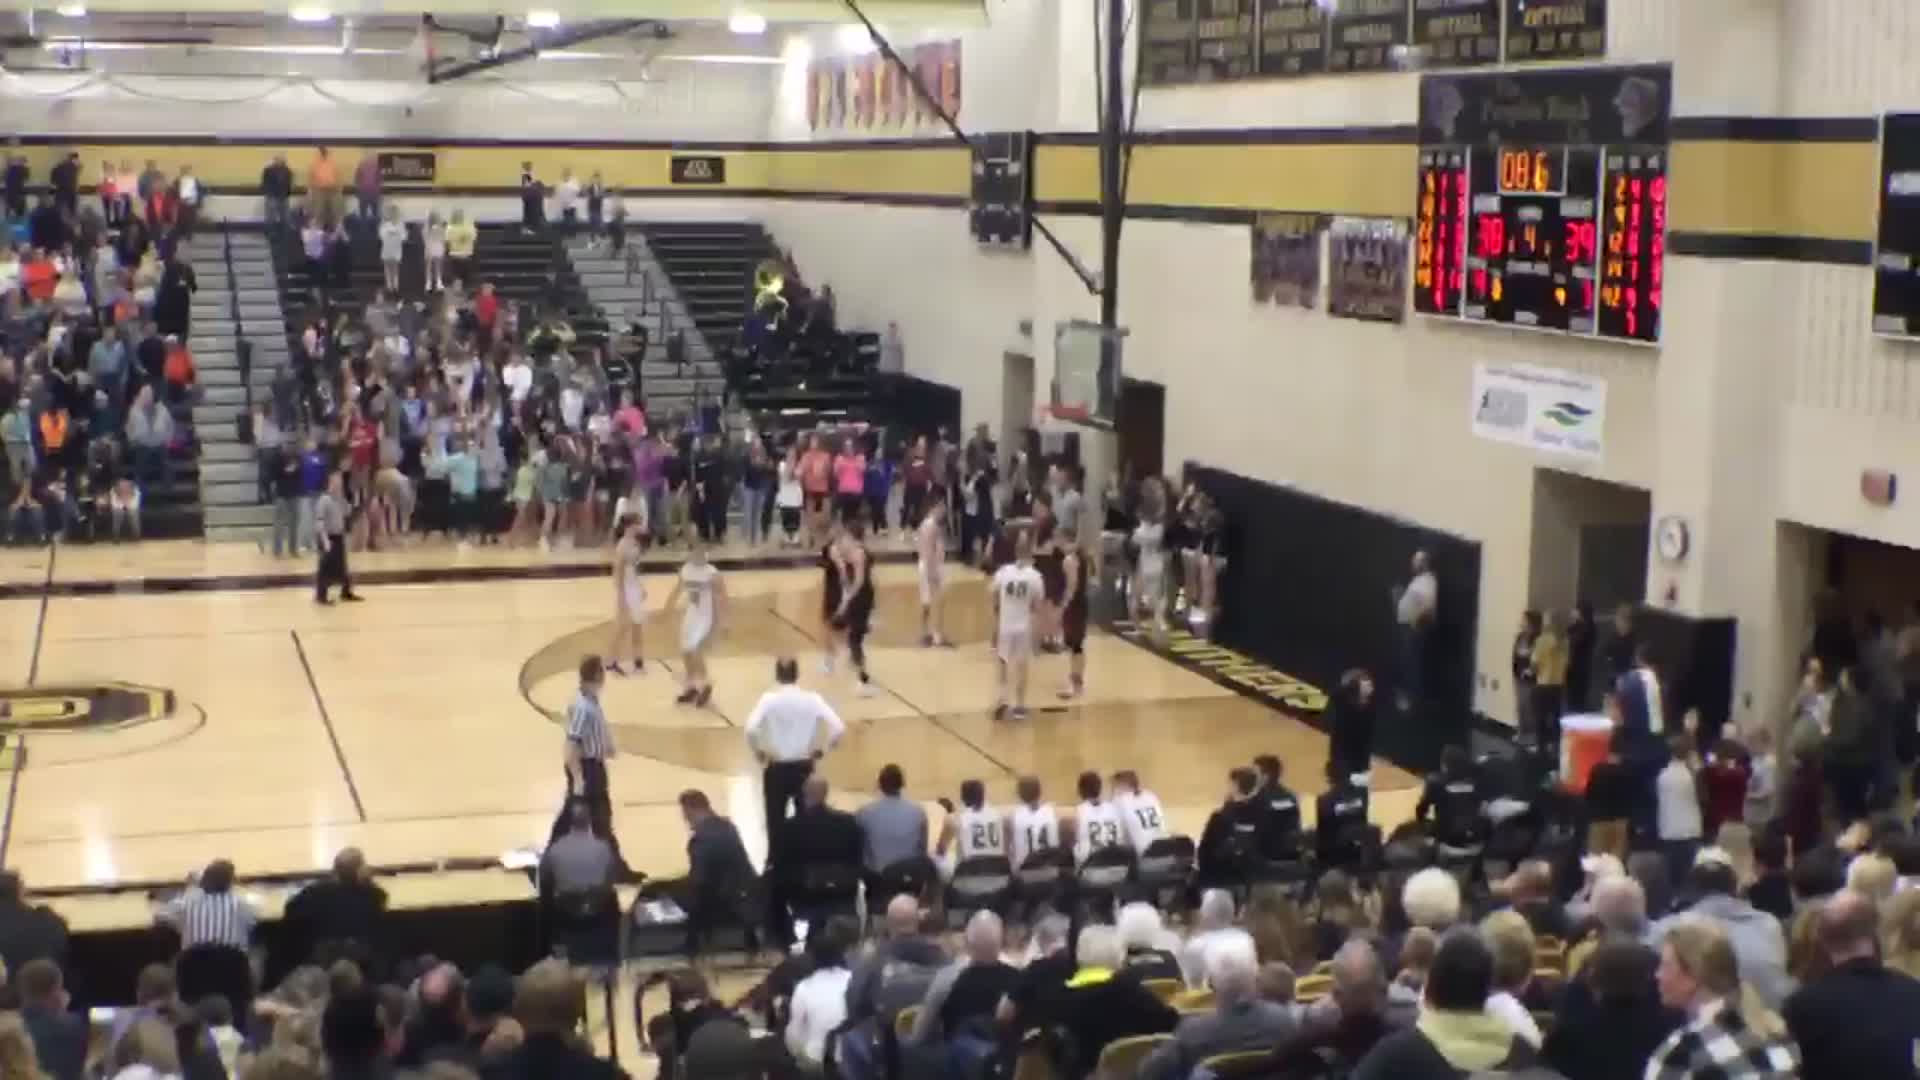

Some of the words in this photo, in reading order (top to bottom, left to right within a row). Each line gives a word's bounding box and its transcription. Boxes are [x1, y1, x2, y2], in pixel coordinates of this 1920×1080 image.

[1564, 221, 1596, 264] 39
[1136, 805, 1159, 829] 12
[972, 821, 1000, 849] 20
[1026, 823, 1051, 850] 14
[1088, 820, 1118, 849] 23
